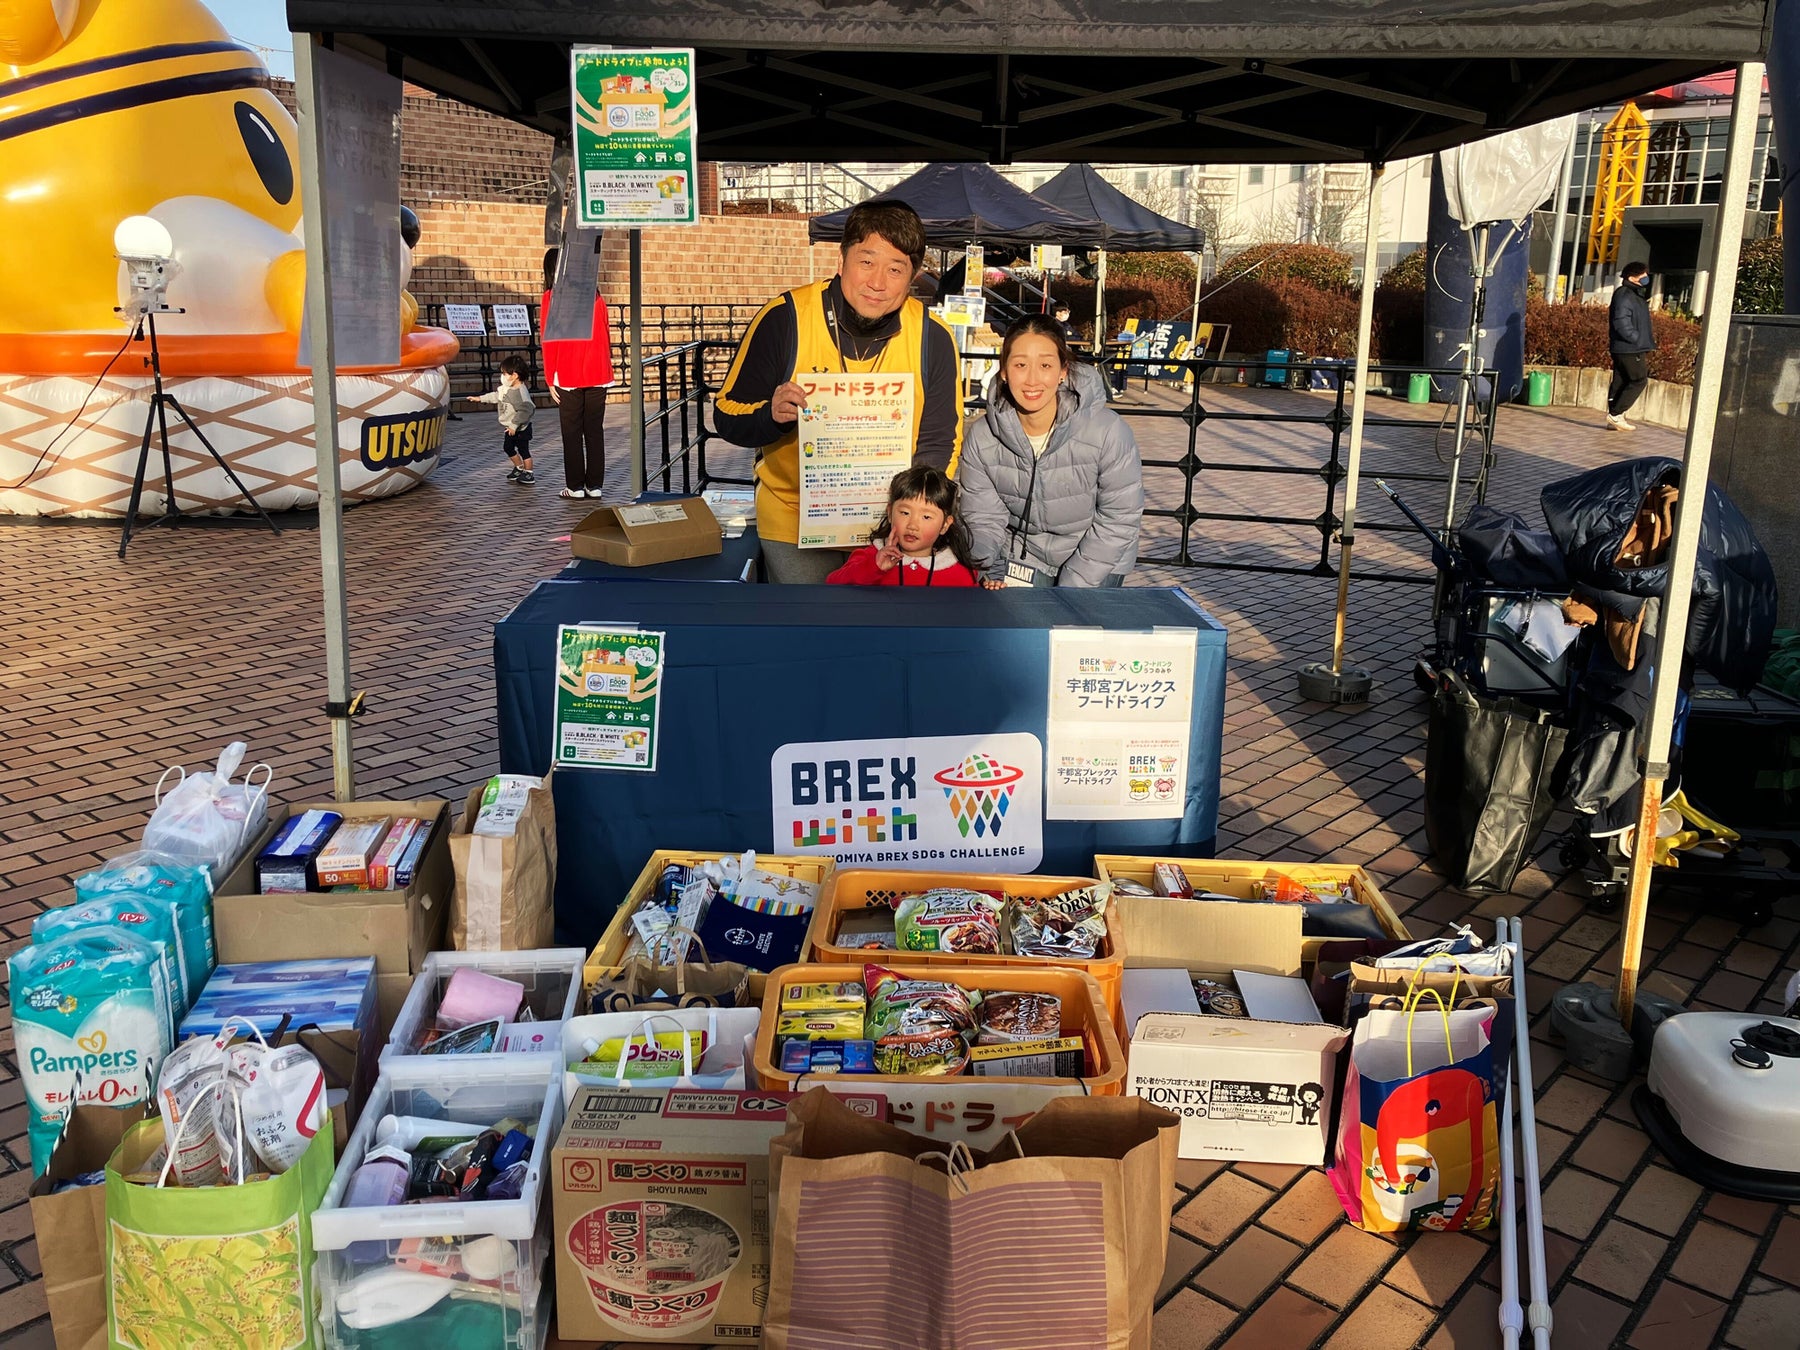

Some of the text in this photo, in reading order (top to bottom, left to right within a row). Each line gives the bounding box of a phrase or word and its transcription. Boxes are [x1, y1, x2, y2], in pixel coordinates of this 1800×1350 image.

[803, 381, 905, 397] フードドライブ
[1008, 562, 1034, 582] TENANT
[1079, 658, 1100, 666] BREX
[1066, 679, 1176, 694] 宇都宮ブレックス
[1078, 695, 1167, 709] フードドライブ
[1129, 755, 1156, 765] BREX
[1057, 768, 1118, 777] 宇都宮ブレックス
[791, 757, 916, 805] BREX
[1063, 777, 1112, 785] フードドライブ
[792, 807, 917, 847] with
[877, 852, 909, 862] BREX
[912, 849, 945, 859] SDGs
[950, 846, 1025, 858] CHALLENGE
[324, 873, 338, 882] 50
[30, 1048, 138, 1075] Pampers
[1135, 1076, 1210, 1087] 初心者からプロまで大満足!
[1136, 1087, 1209, 1104] LION FX
[256, 1122, 287, 1136] おふろ
[261, 1135, 282, 1148] 洗剤
[614, 1163, 687, 1180] 麺づくり
[693, 1168, 741, 1179] 鶏ガラ醤油
[568, 1182, 598, 1190] マルちゃん
[647, 1186, 708, 1196] SHOYU RAMEN
[606, 1210, 639, 1264] 麺づくり
[607, 1291, 706, 1311] 麺づくり
